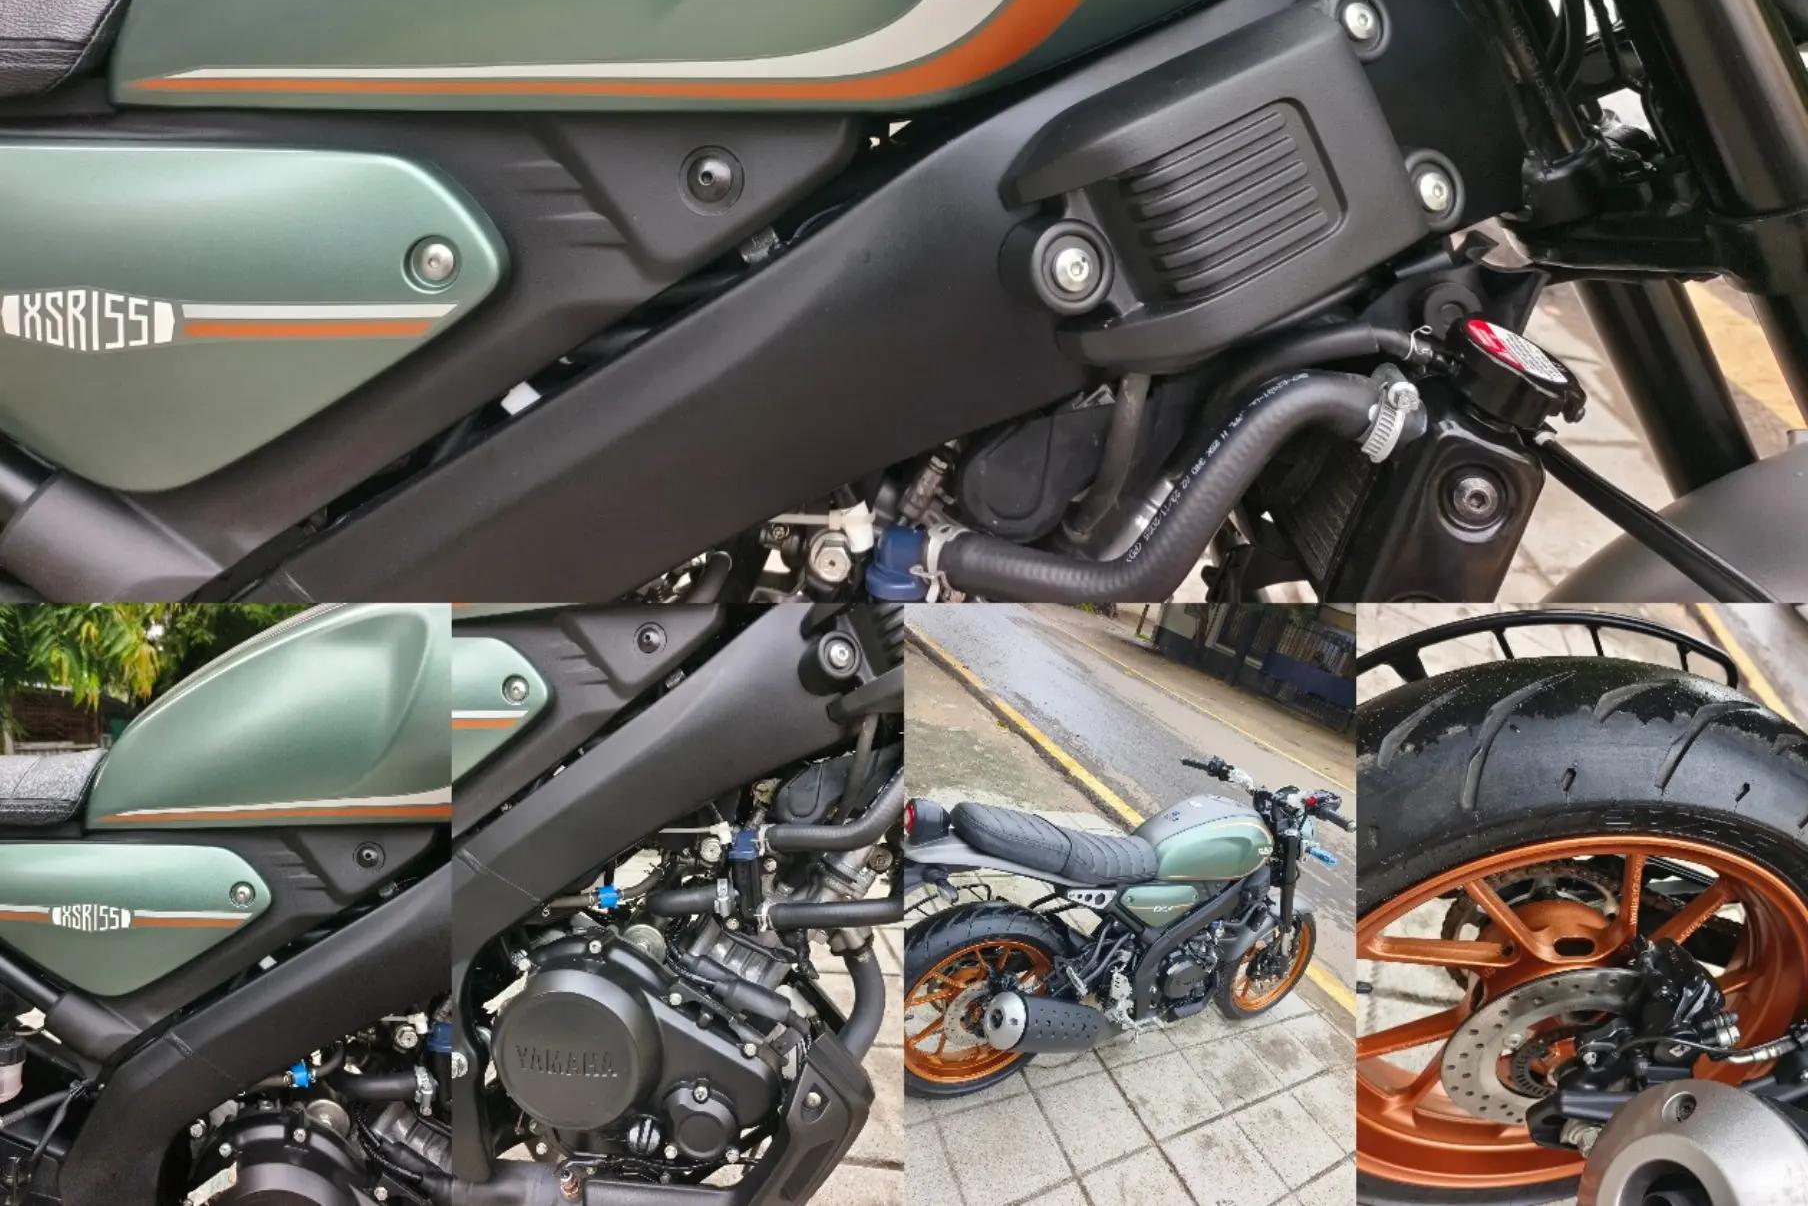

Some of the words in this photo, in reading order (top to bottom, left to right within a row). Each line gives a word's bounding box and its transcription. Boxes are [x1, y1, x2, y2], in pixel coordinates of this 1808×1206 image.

[23, 289, 149, 351] XSR155
[62, 904, 119, 932] XSR155
[515, 1044, 618, 1077] YAMAHA
